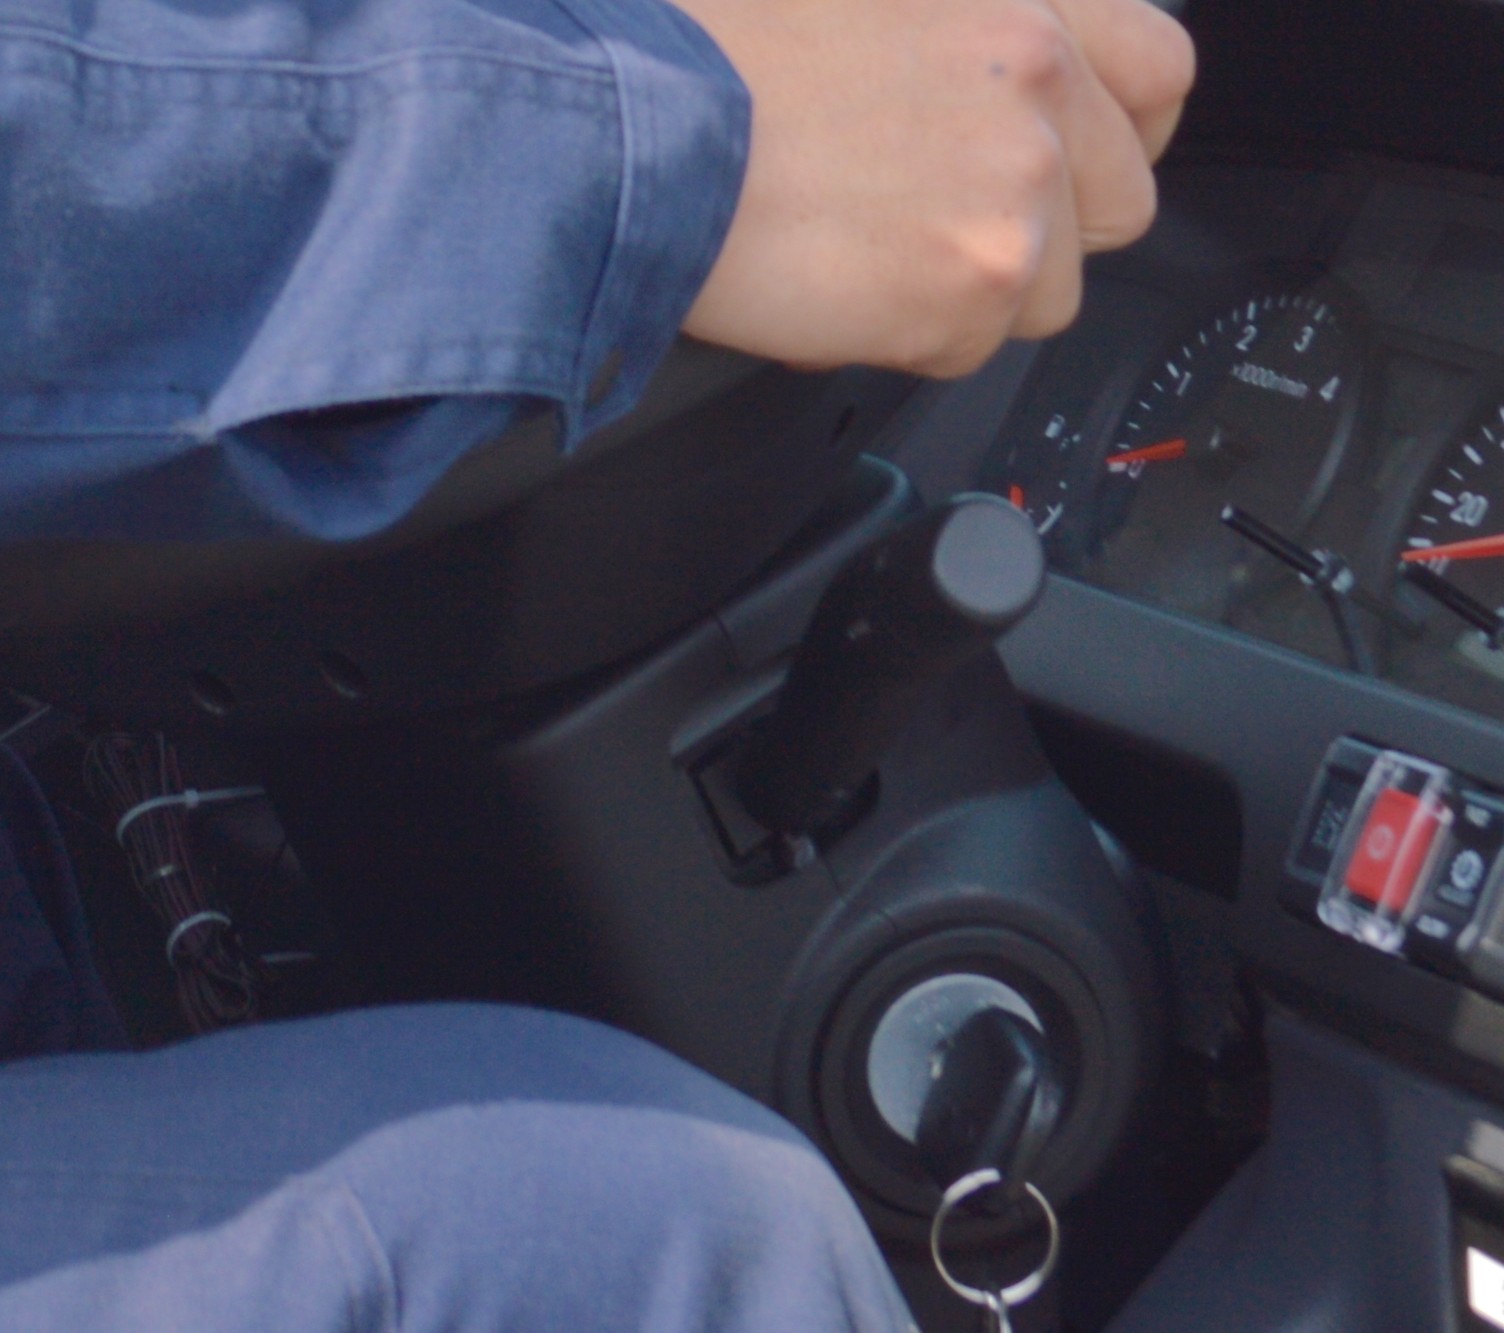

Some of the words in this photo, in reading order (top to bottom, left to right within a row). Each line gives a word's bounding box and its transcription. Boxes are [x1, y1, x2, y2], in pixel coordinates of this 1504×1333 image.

[1235, 324, 1257, 351] 2
[1293, 325, 1314, 353] 3
[1318, 376, 1340, 402] 4
[1449, 490, 1489, 527] 20
